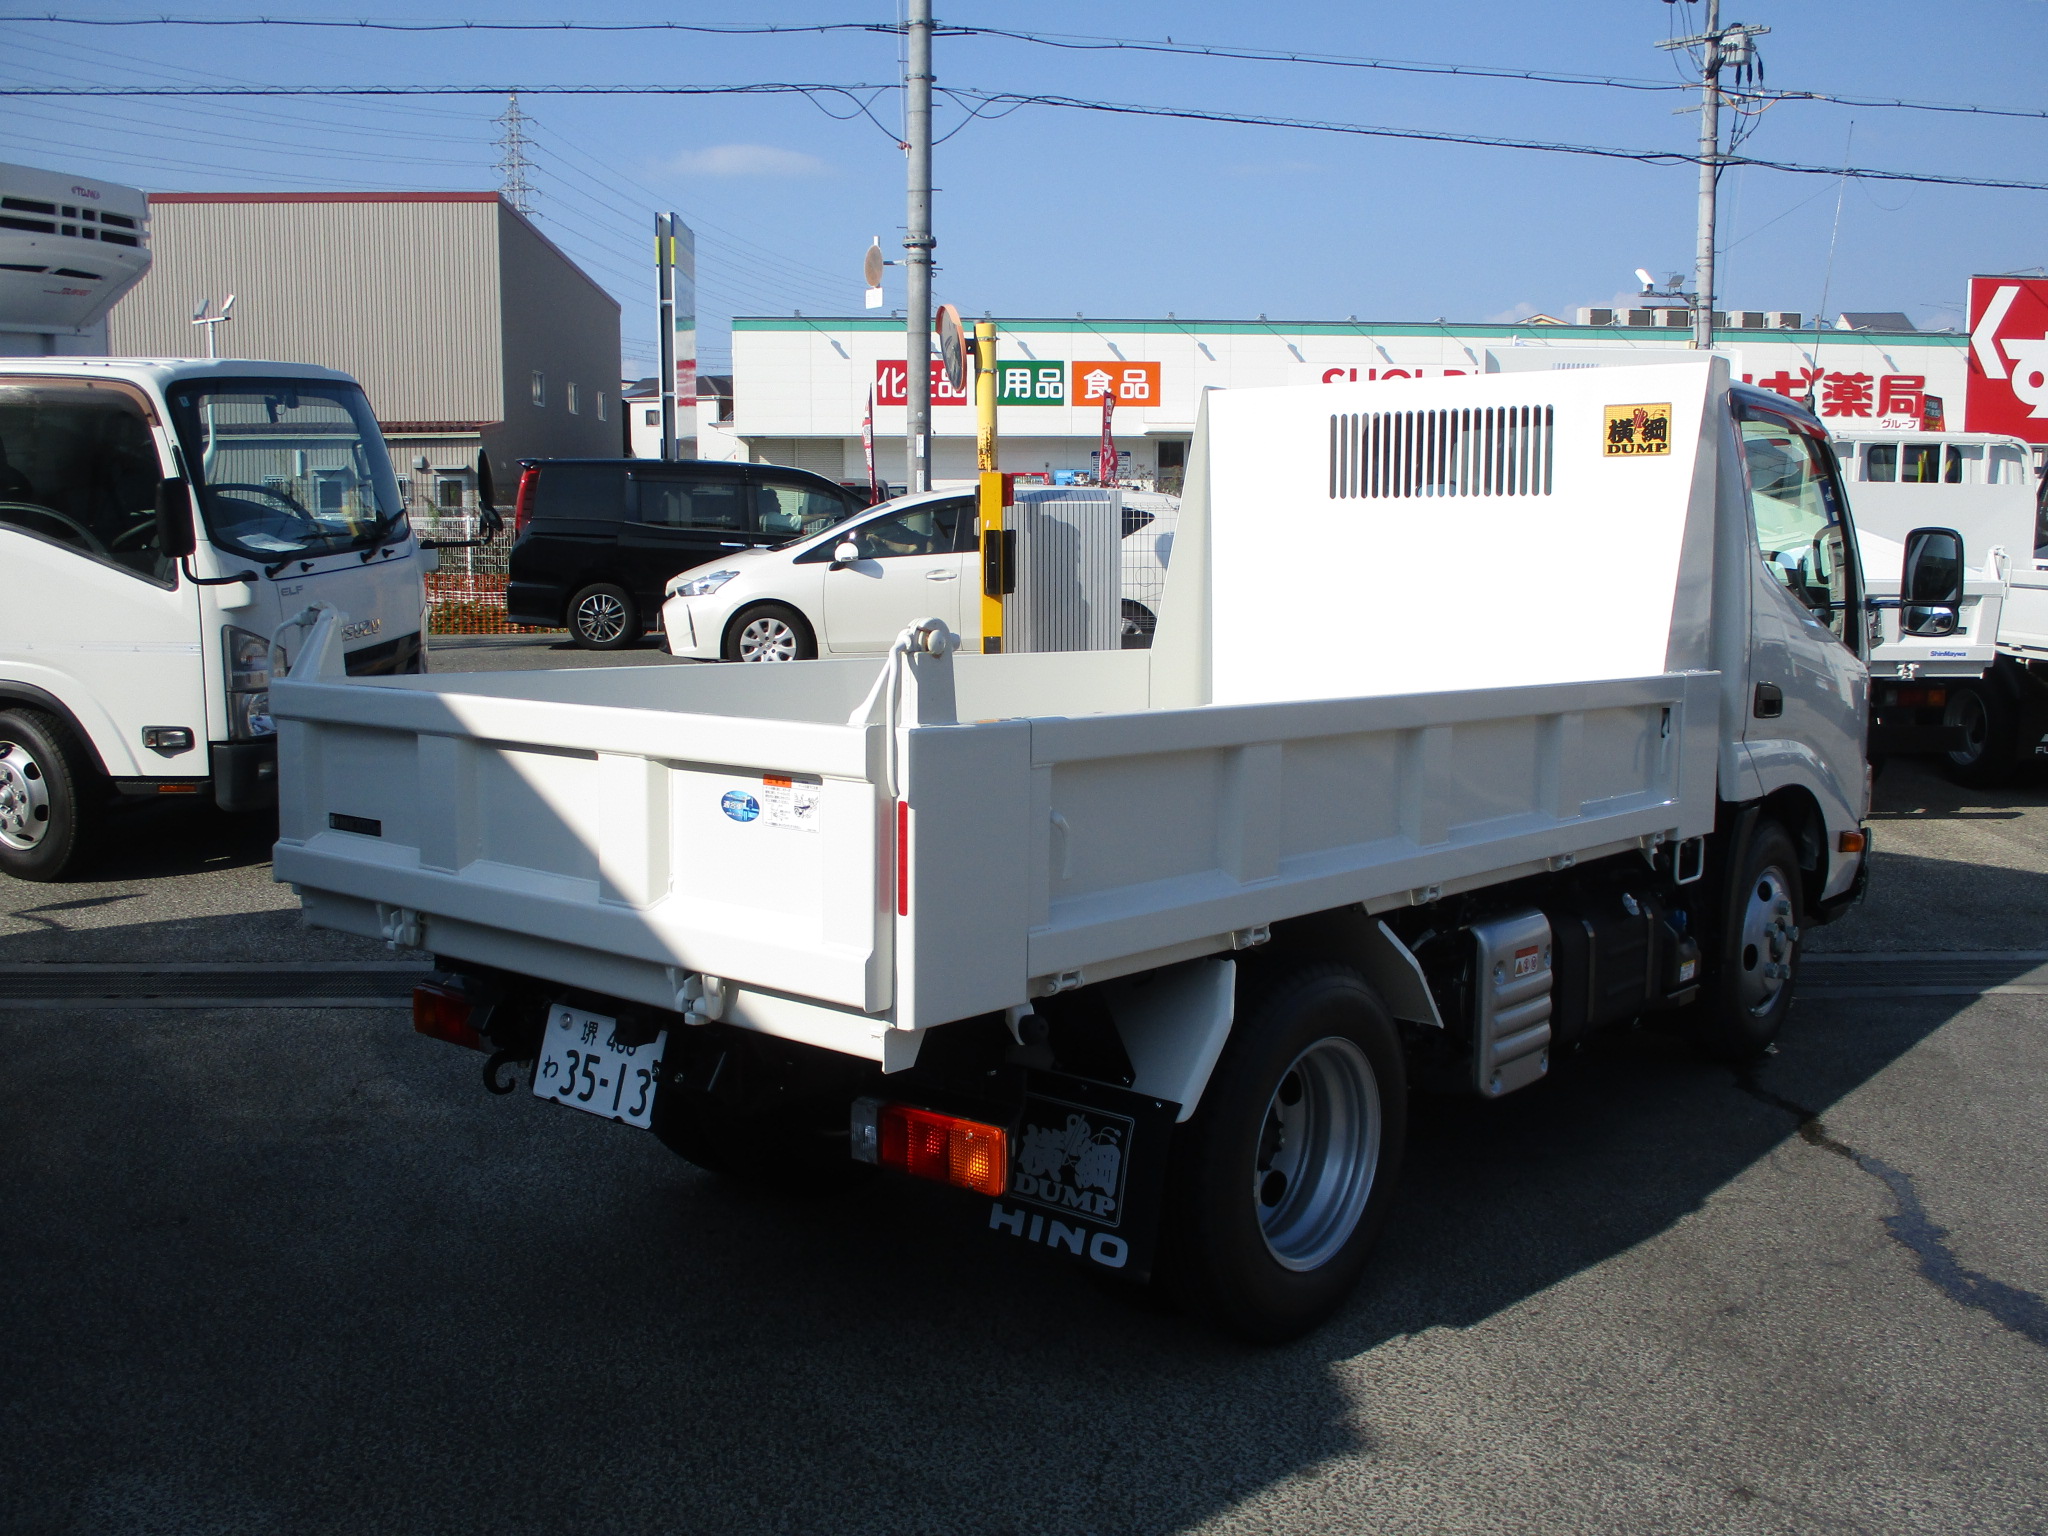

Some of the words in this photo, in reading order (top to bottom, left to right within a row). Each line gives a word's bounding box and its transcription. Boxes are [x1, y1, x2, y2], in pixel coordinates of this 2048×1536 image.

[997, 368, 1063, 398] 用品
[1083, 368, 1150, 399] 食品
[1881, 418, 1919, 429] グループ
[1607, 443, 1668, 454] DUMP
[281, 585, 303, 597] ELF
[1930, 650, 1967, 658] ShinMaywa
[580, 1020, 599, 1046] 堺
[542, 1054, 559, 1079] わ
[558, 1049, 652, 1117] 35-13
[1013, 1171, 1116, 1217] DUMP
[989, 1202, 1129, 1268] HINO
